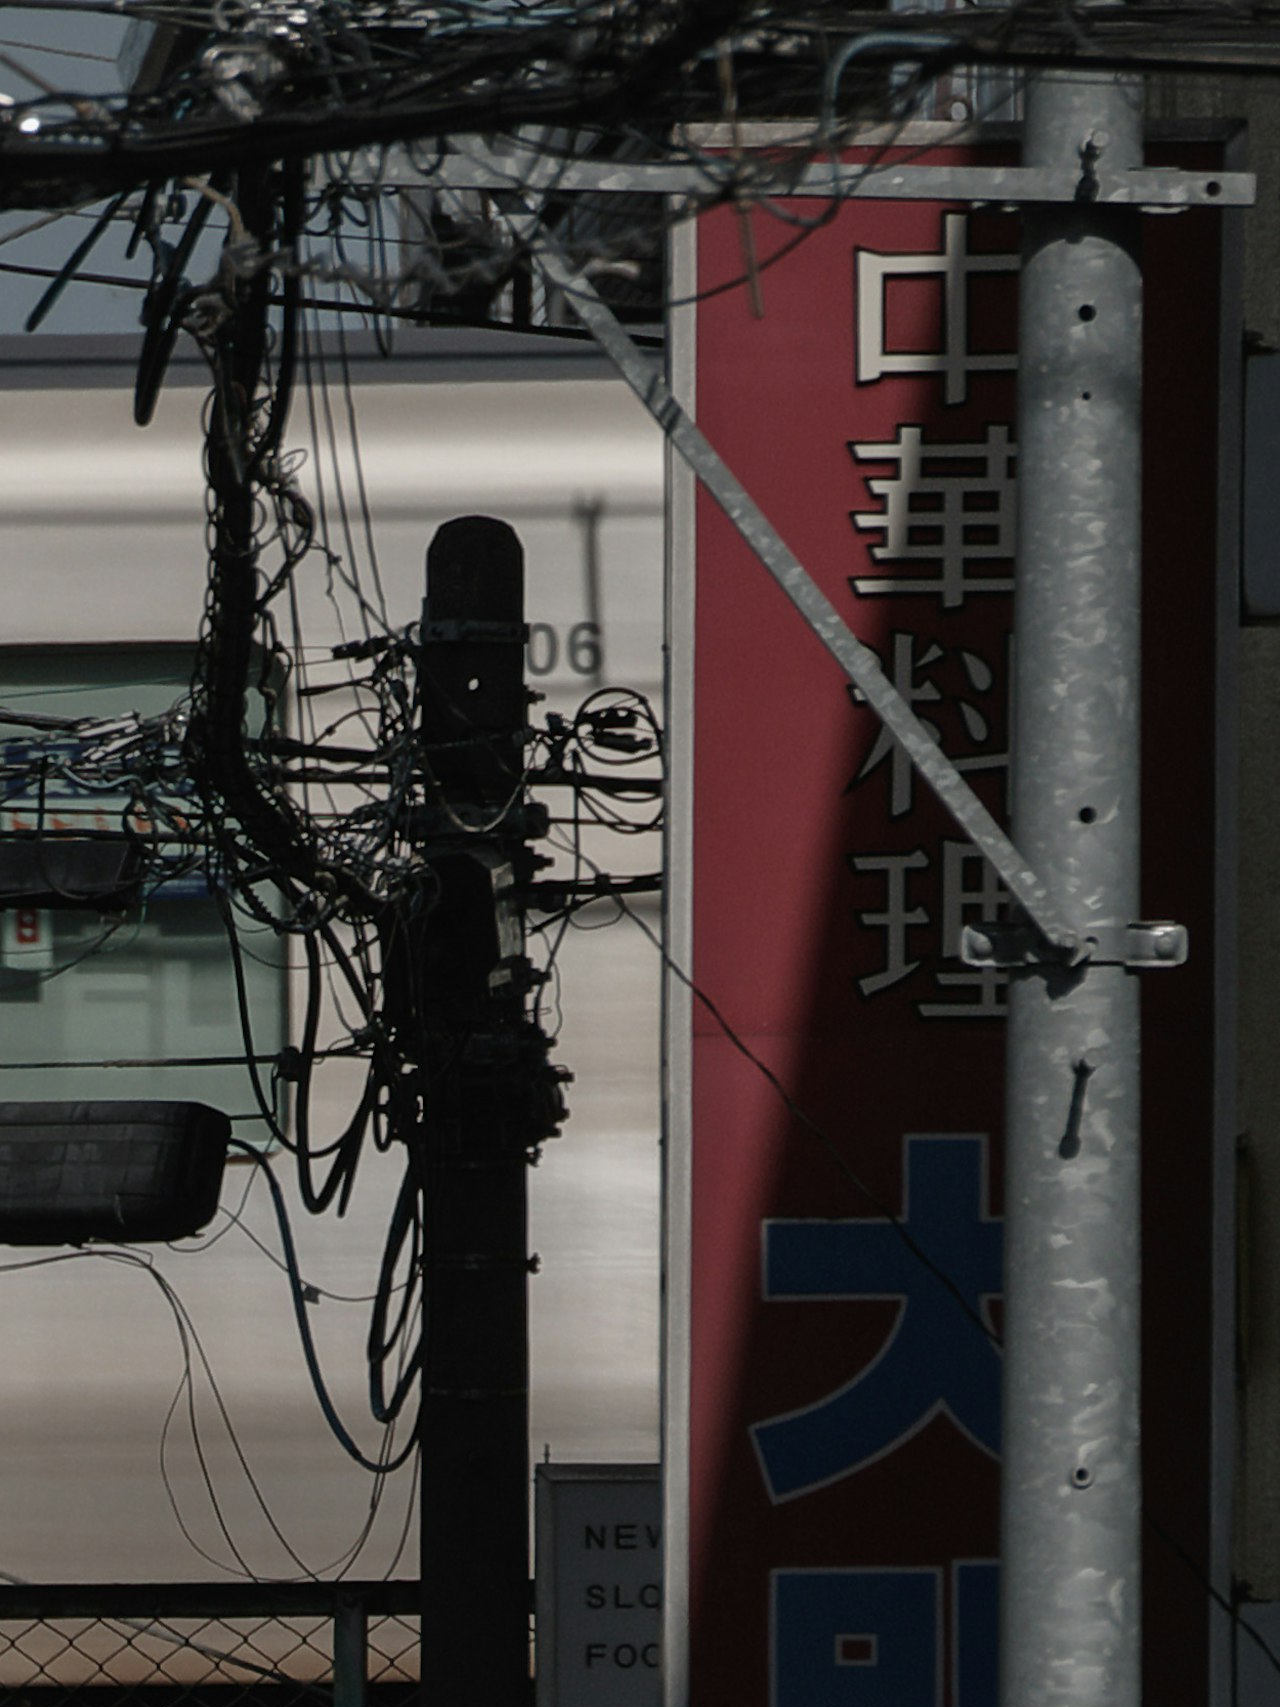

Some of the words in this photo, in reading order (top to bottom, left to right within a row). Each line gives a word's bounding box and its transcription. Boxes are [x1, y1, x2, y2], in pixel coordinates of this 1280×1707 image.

[848, 212, 1021, 1020] 中華料理
[527, 622, 603, 676] 06
[585, 1584, 662, 1609] SLO
[585, 1643, 661, 1668] FOO
